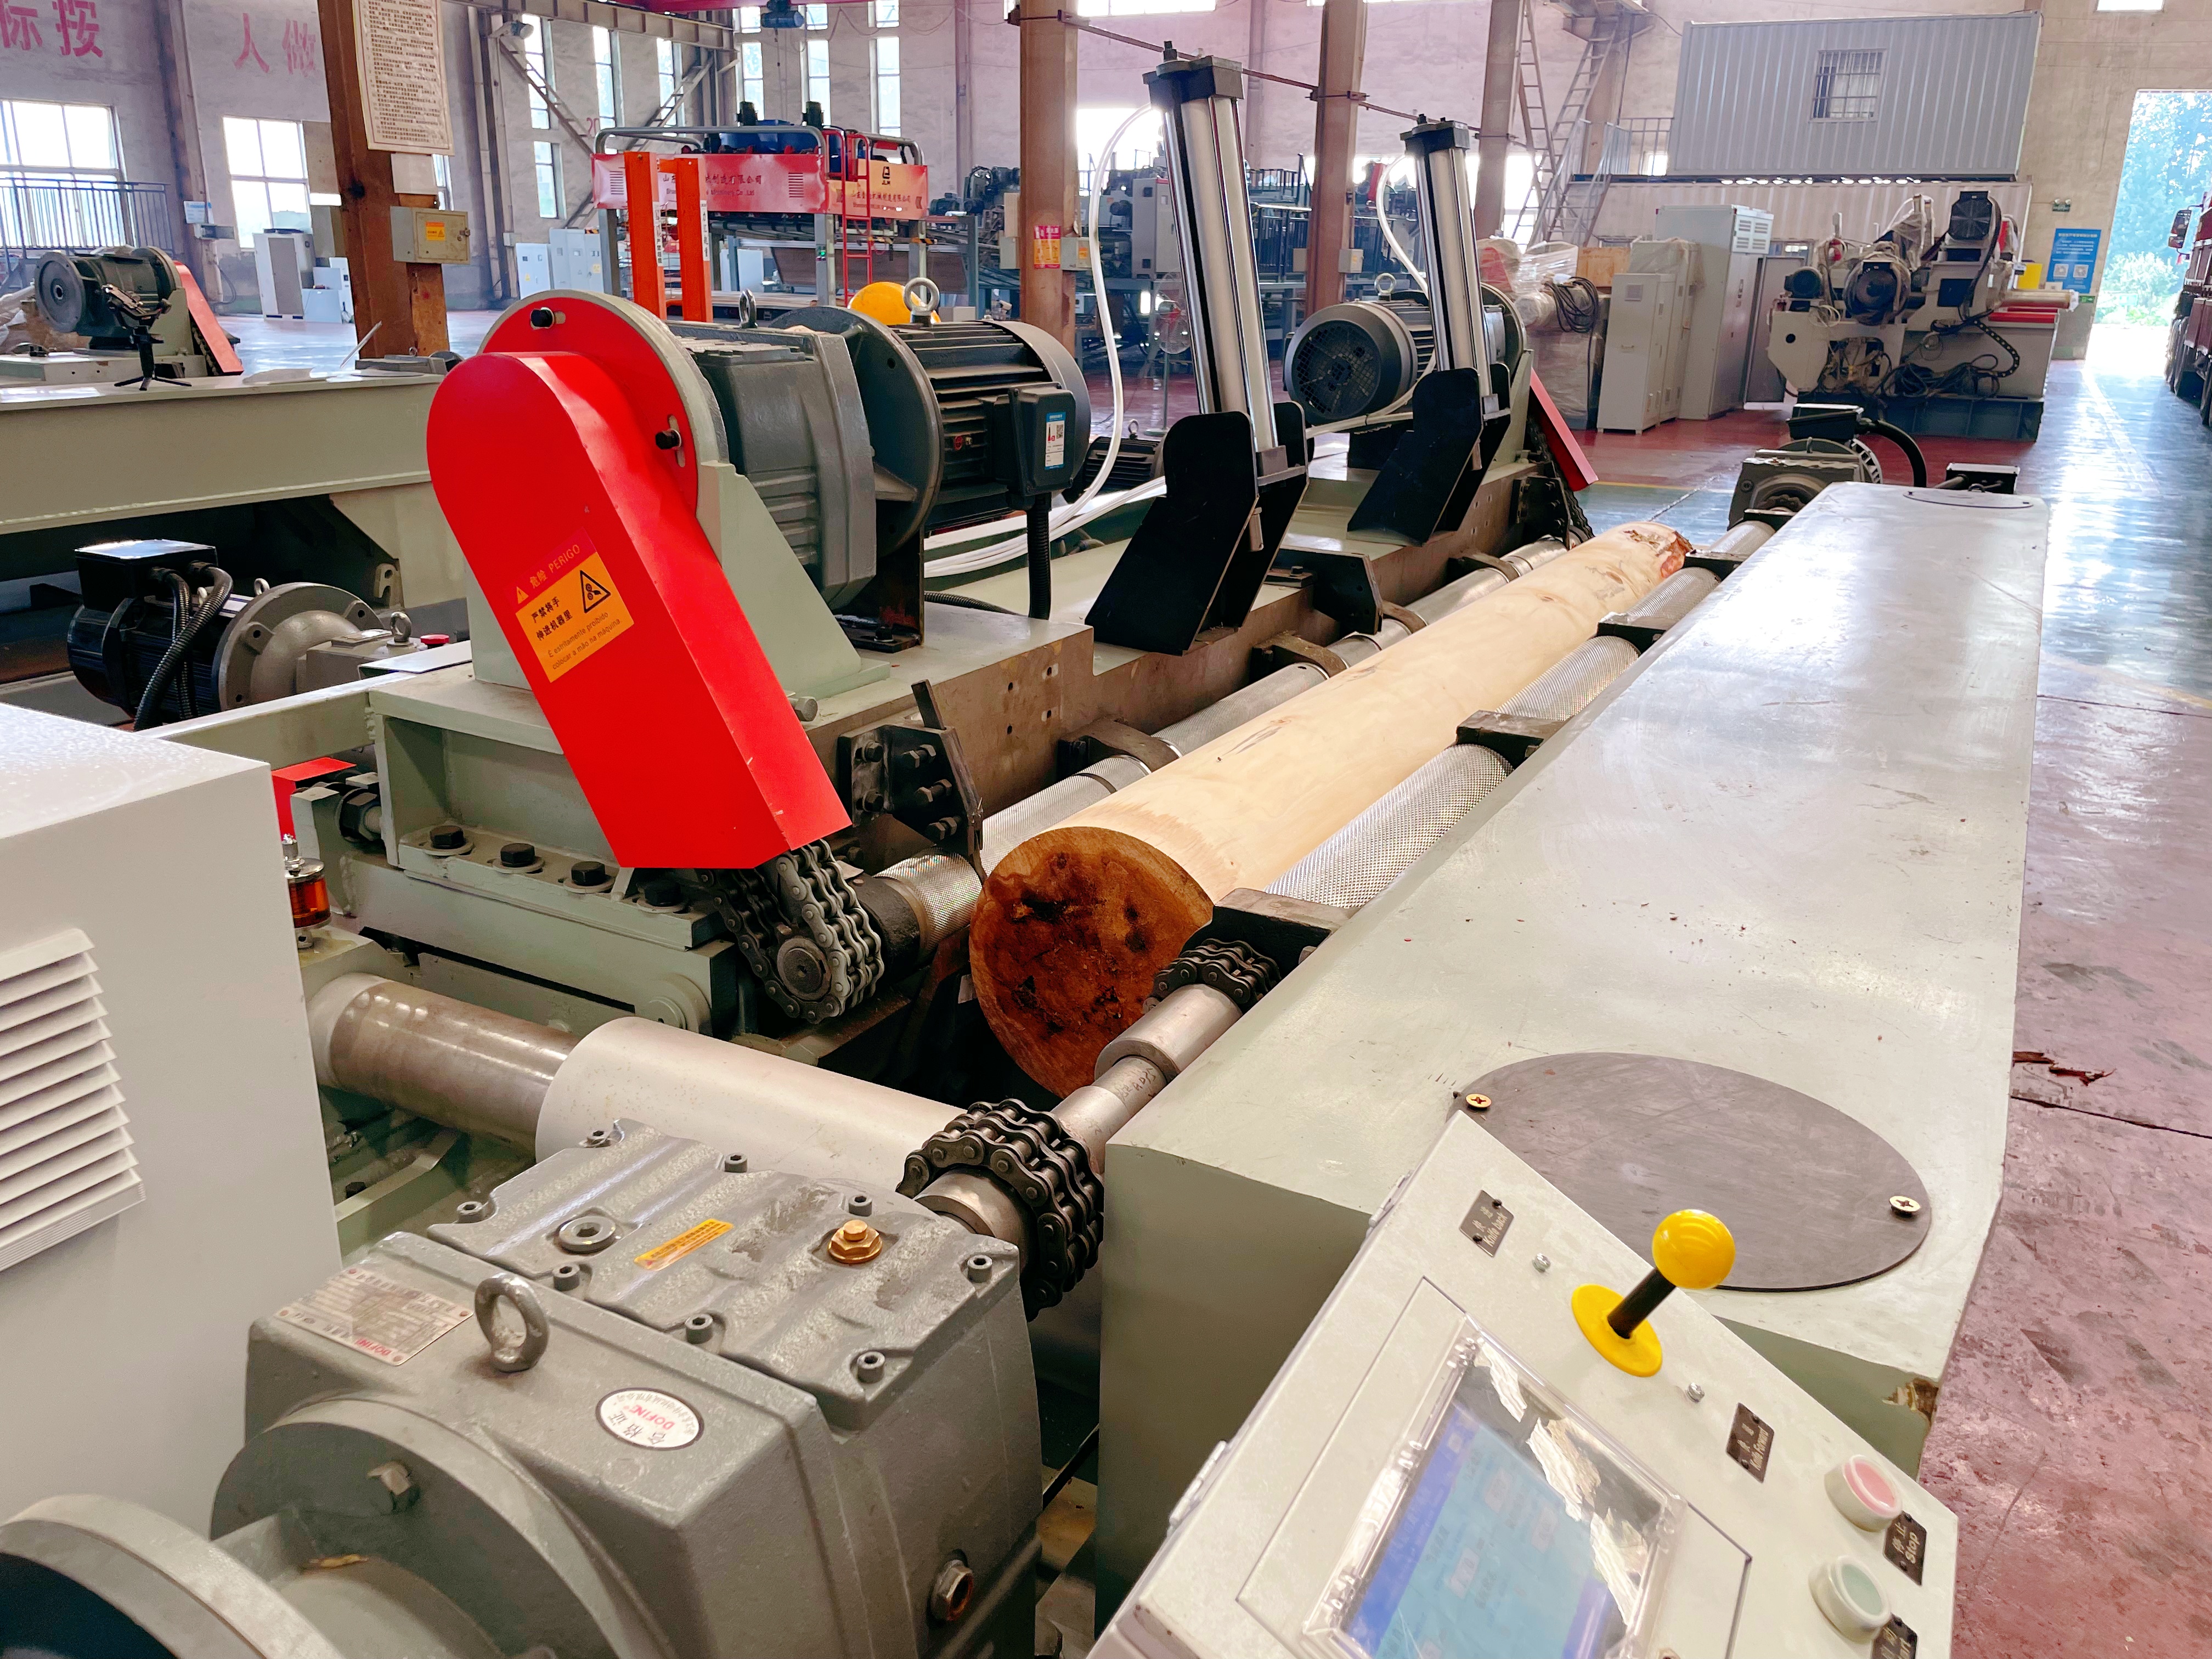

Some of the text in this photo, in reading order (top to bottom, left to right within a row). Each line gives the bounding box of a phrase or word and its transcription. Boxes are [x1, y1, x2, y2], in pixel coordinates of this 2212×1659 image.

[528, 544, 580, 589] 危险 PERIGO
[531, 595, 560, 624] 严禁将手
[535, 609, 573, 641] 伸进机器里
[548, 611, 609, 658] É estritamente proibido
[552, 653, 573, 670] colocar
[577, 640, 590, 653] mão
[589, 634, 598, 644] na
[597, 617, 621, 639] máquina
[1482, 1211, 1509, 1248] Knife back
[607, 1410, 669, 1446] 合格证
[1893, 1521, 1908, 1554] 停止
[1905, 1531, 1921, 1565] Stop
